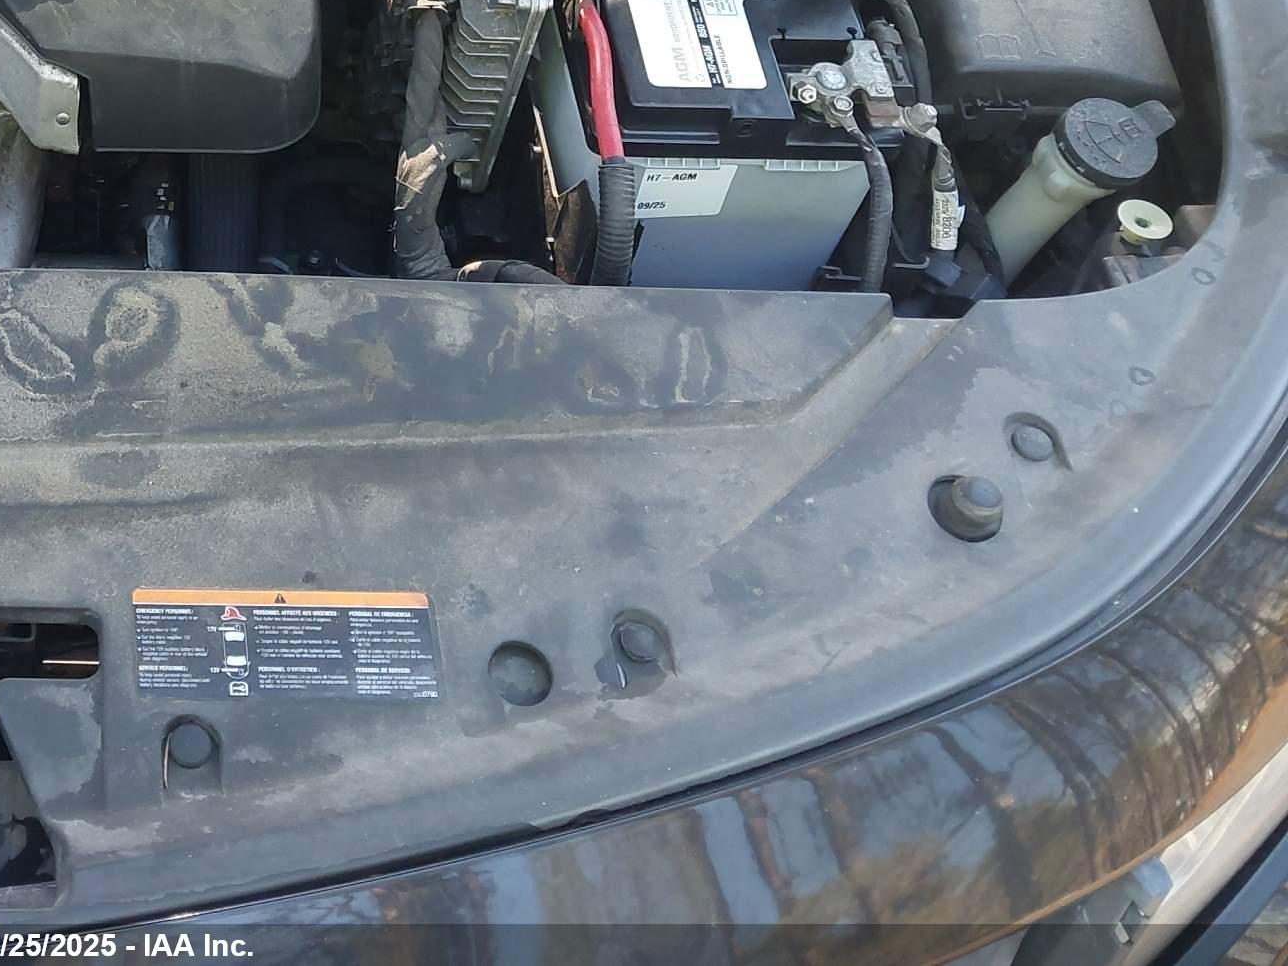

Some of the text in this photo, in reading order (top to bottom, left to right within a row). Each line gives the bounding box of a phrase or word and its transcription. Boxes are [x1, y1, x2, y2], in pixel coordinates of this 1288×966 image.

[696, 23, 708, 39] 850
[672, 47, 692, 82] AGM
[702, 44, 718, 73] H7-AGM
[714, 34, 733, 84] NON-SPILLABLE
[638, 202, 666, 210] 09/25
